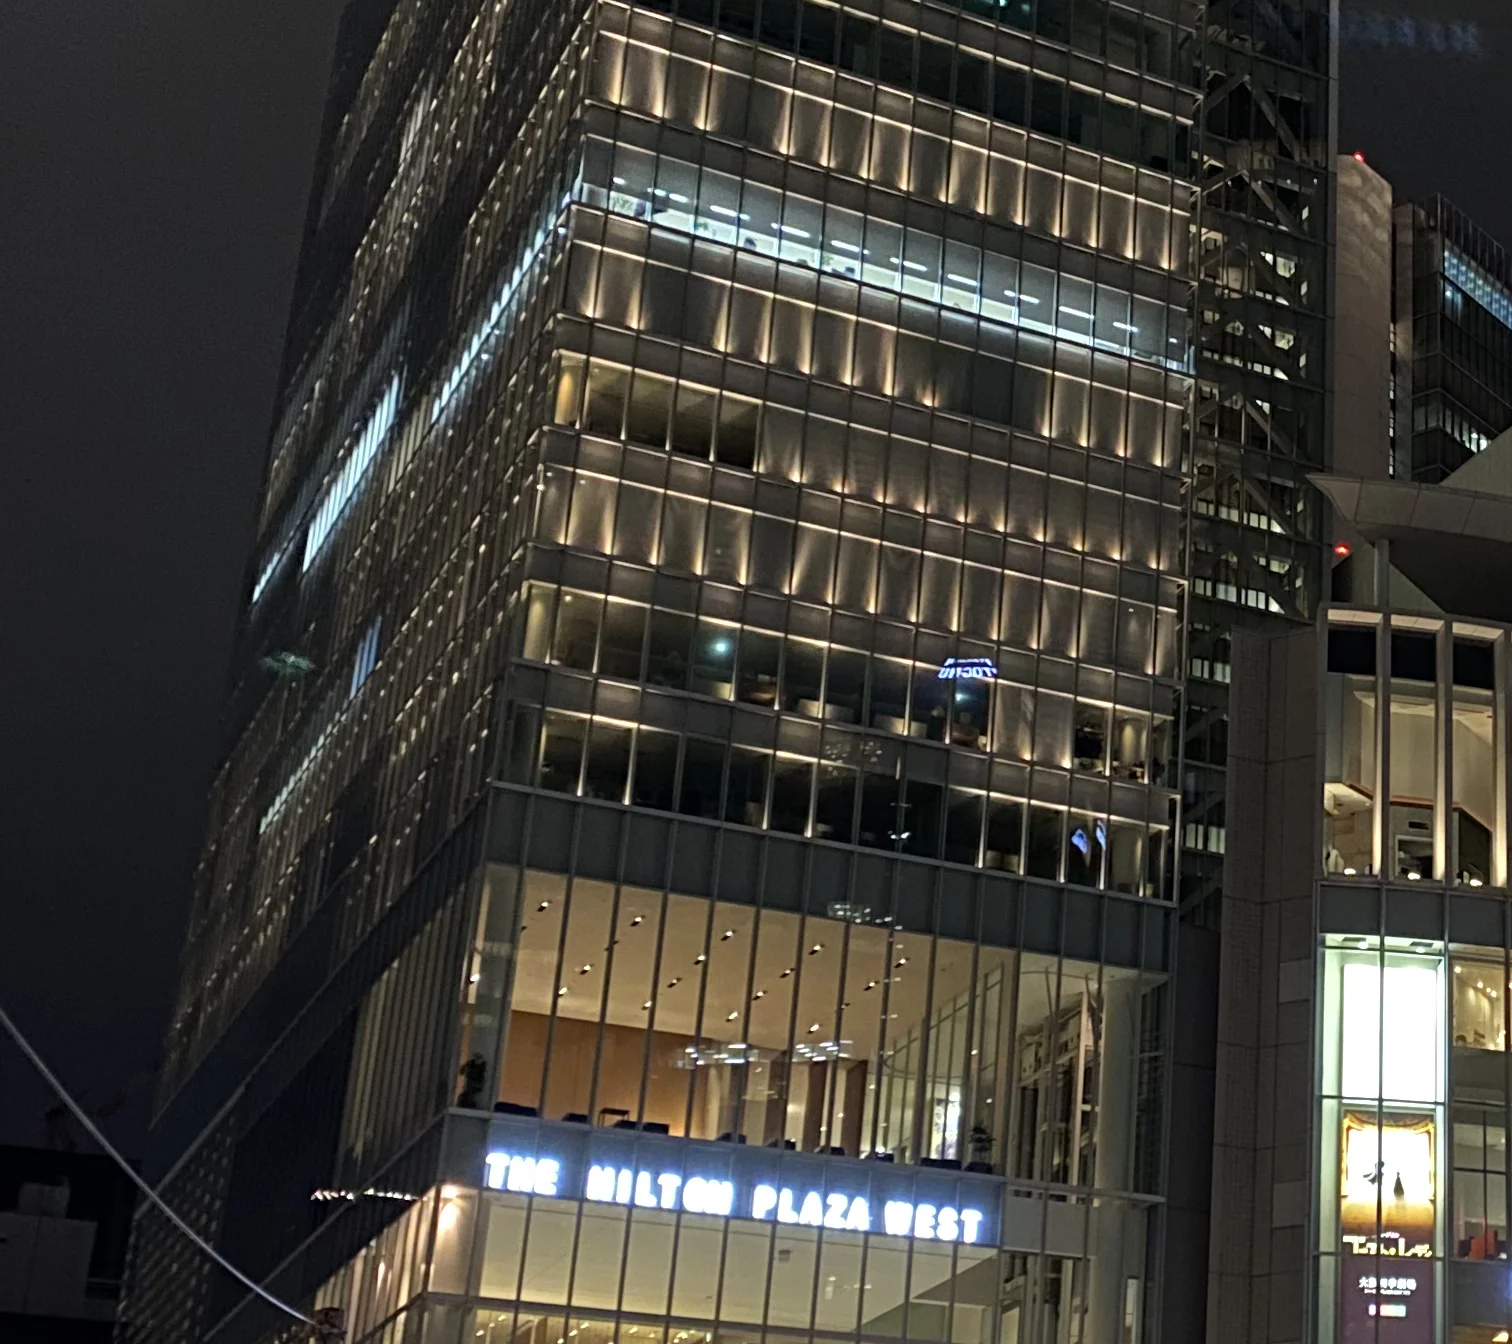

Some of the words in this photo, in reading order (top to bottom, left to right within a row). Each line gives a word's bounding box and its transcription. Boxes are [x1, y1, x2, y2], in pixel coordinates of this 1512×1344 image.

[485, 1151, 561, 1196] THE
[586, 1164, 735, 1216] HILTON
[751, 1184, 873, 1232] PLAZA
[884, 1200, 983, 1244] WEST
